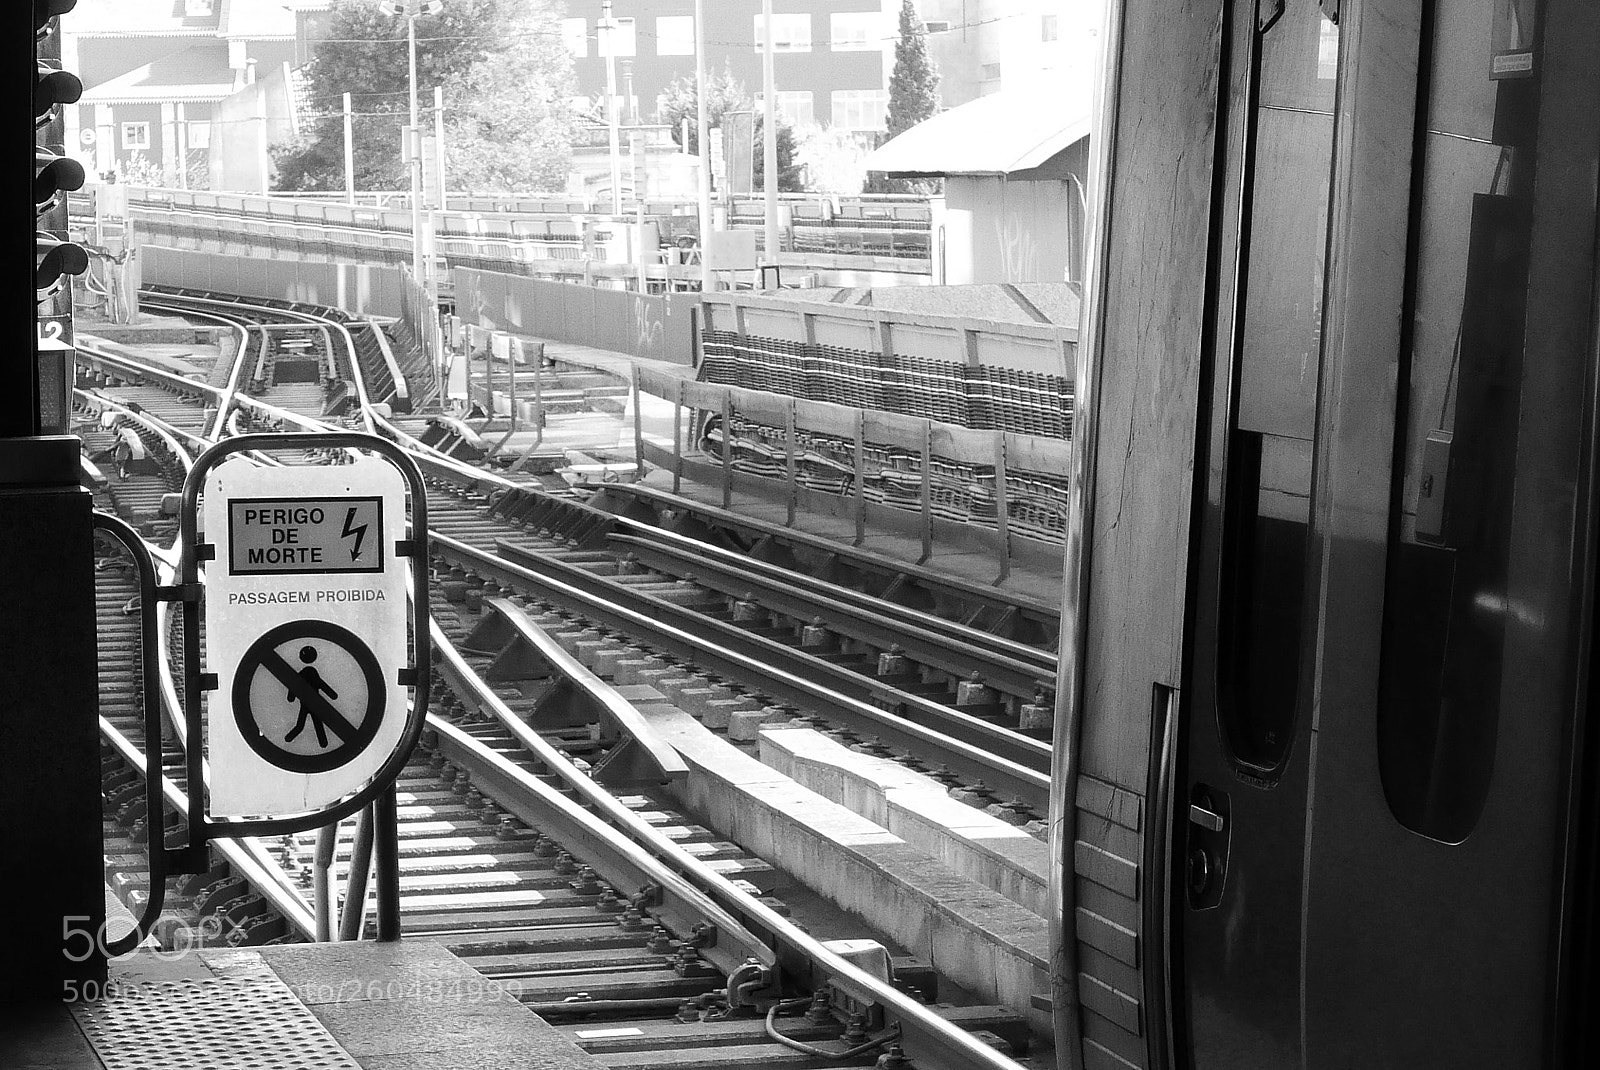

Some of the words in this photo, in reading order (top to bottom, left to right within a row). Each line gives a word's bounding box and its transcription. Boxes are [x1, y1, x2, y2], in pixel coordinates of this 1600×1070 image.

[245, 508, 325, 525] PERIGO
[272, 528, 299, 544] DE
[248, 547, 323, 564] MORTE
[229, 591, 310, 605] PASSAGEM
[316, 589, 386, 603] PROIBIDA
